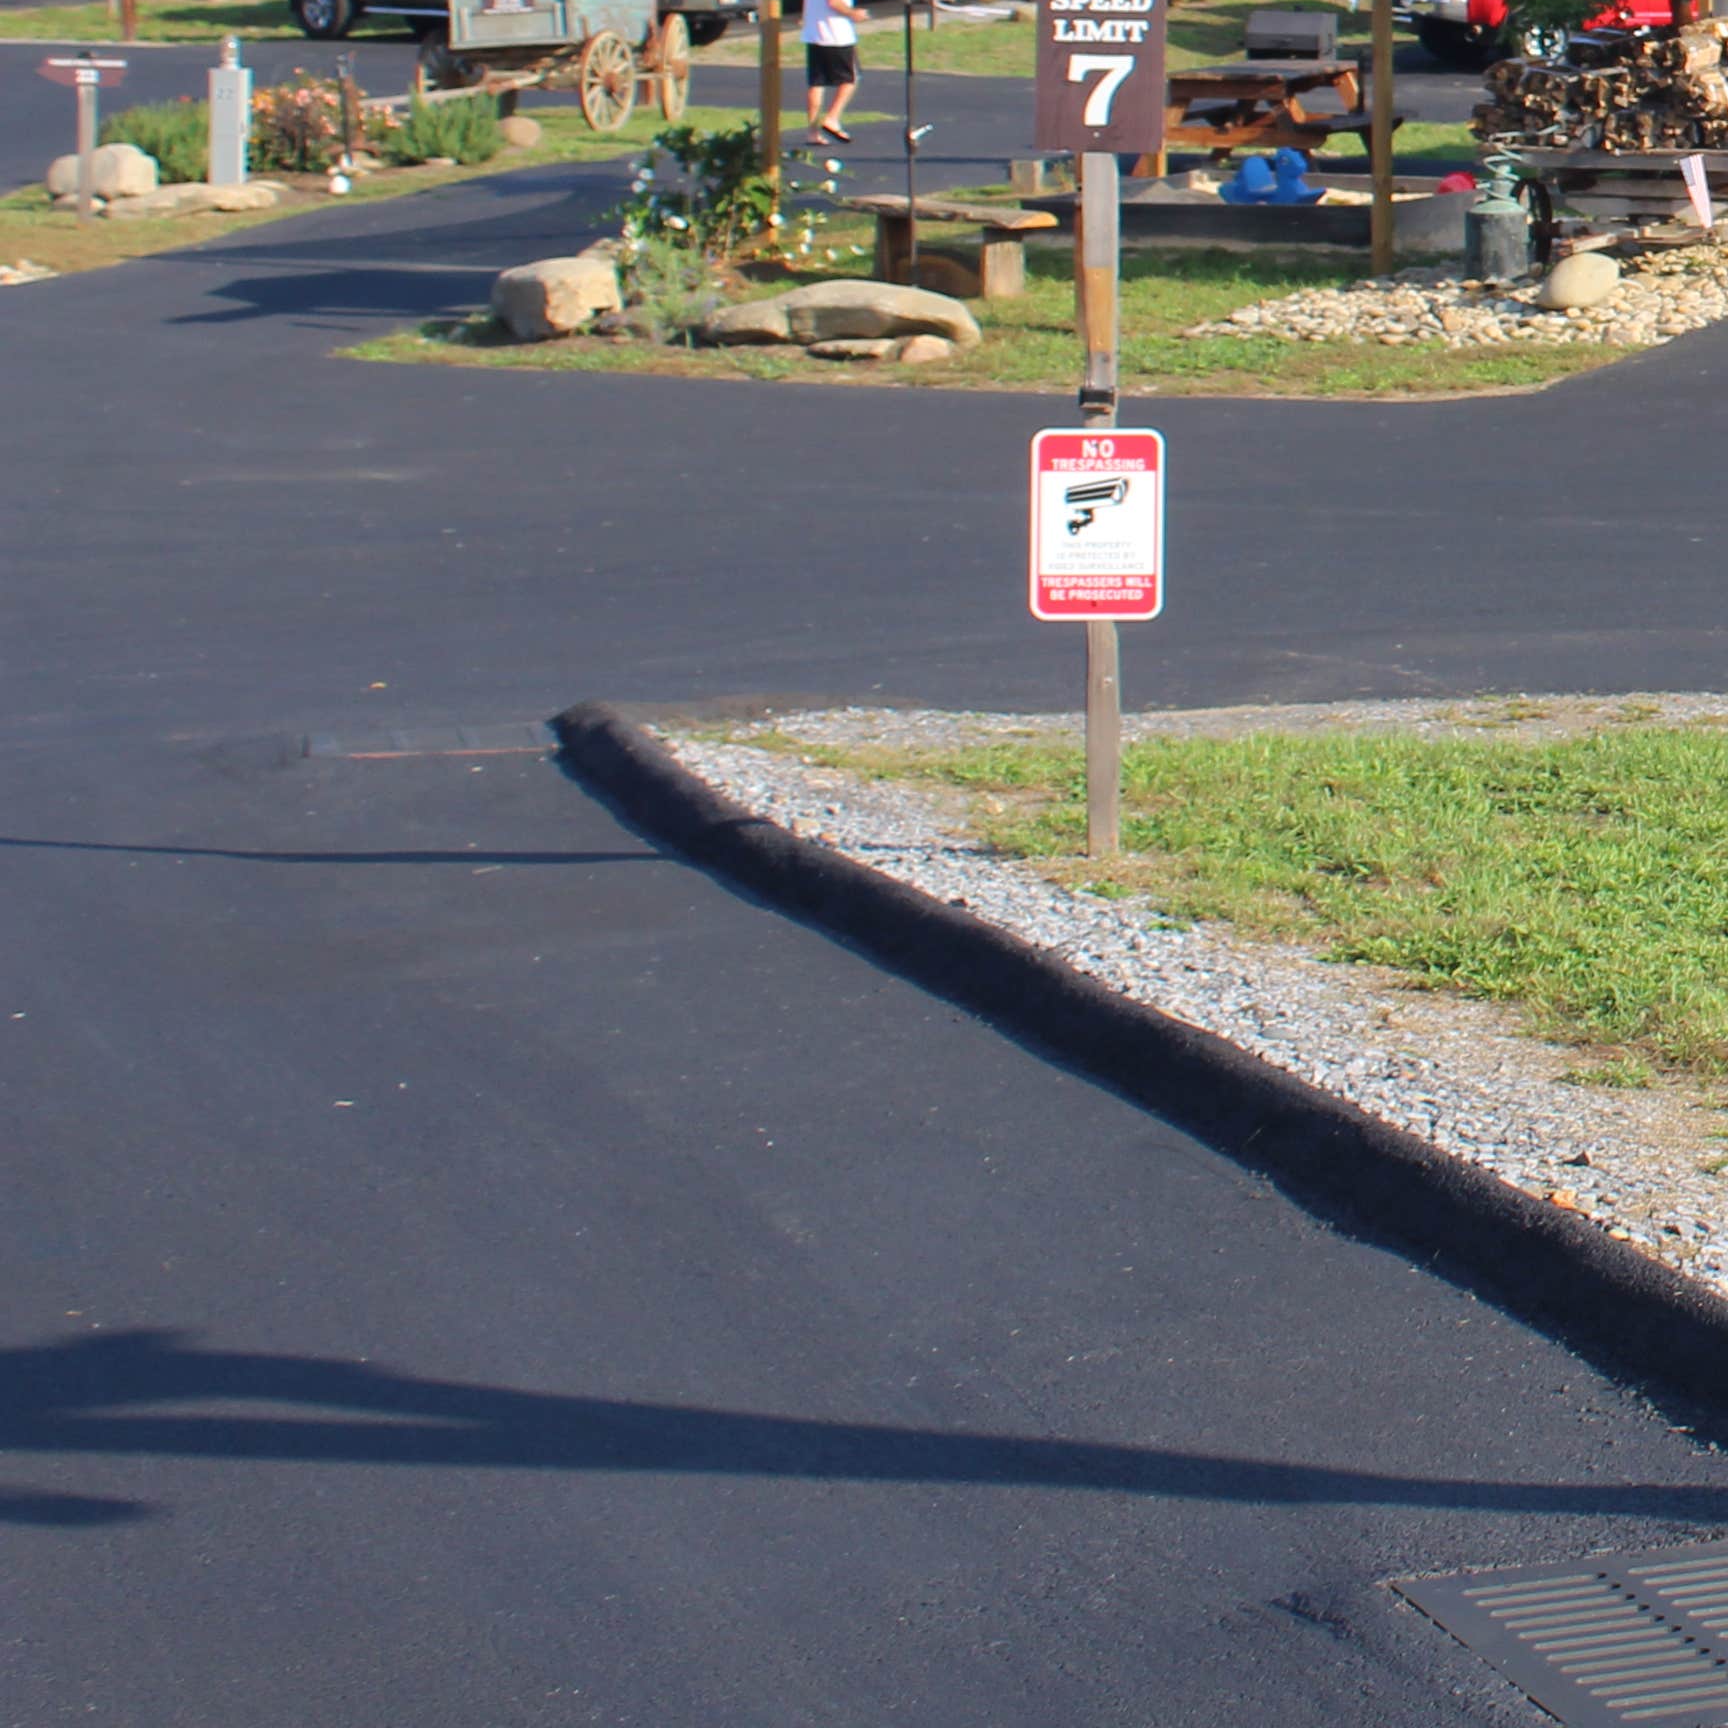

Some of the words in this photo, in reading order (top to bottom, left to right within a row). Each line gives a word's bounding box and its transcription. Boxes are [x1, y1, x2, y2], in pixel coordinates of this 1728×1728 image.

[1053, 18, 1150, 43] LIMIT
[1066, 53, 1136, 127] 7
[1082, 439, 1115, 458] NO
[1051, 458, 1145, 471] TRESPASSING
[1041, 576, 1123, 589] TRESPASSERS
[1125, 576, 1153, 588] WILL
[1050, 589, 1066, 601] BE
[1068, 589, 1145, 601] PROSECUTED
